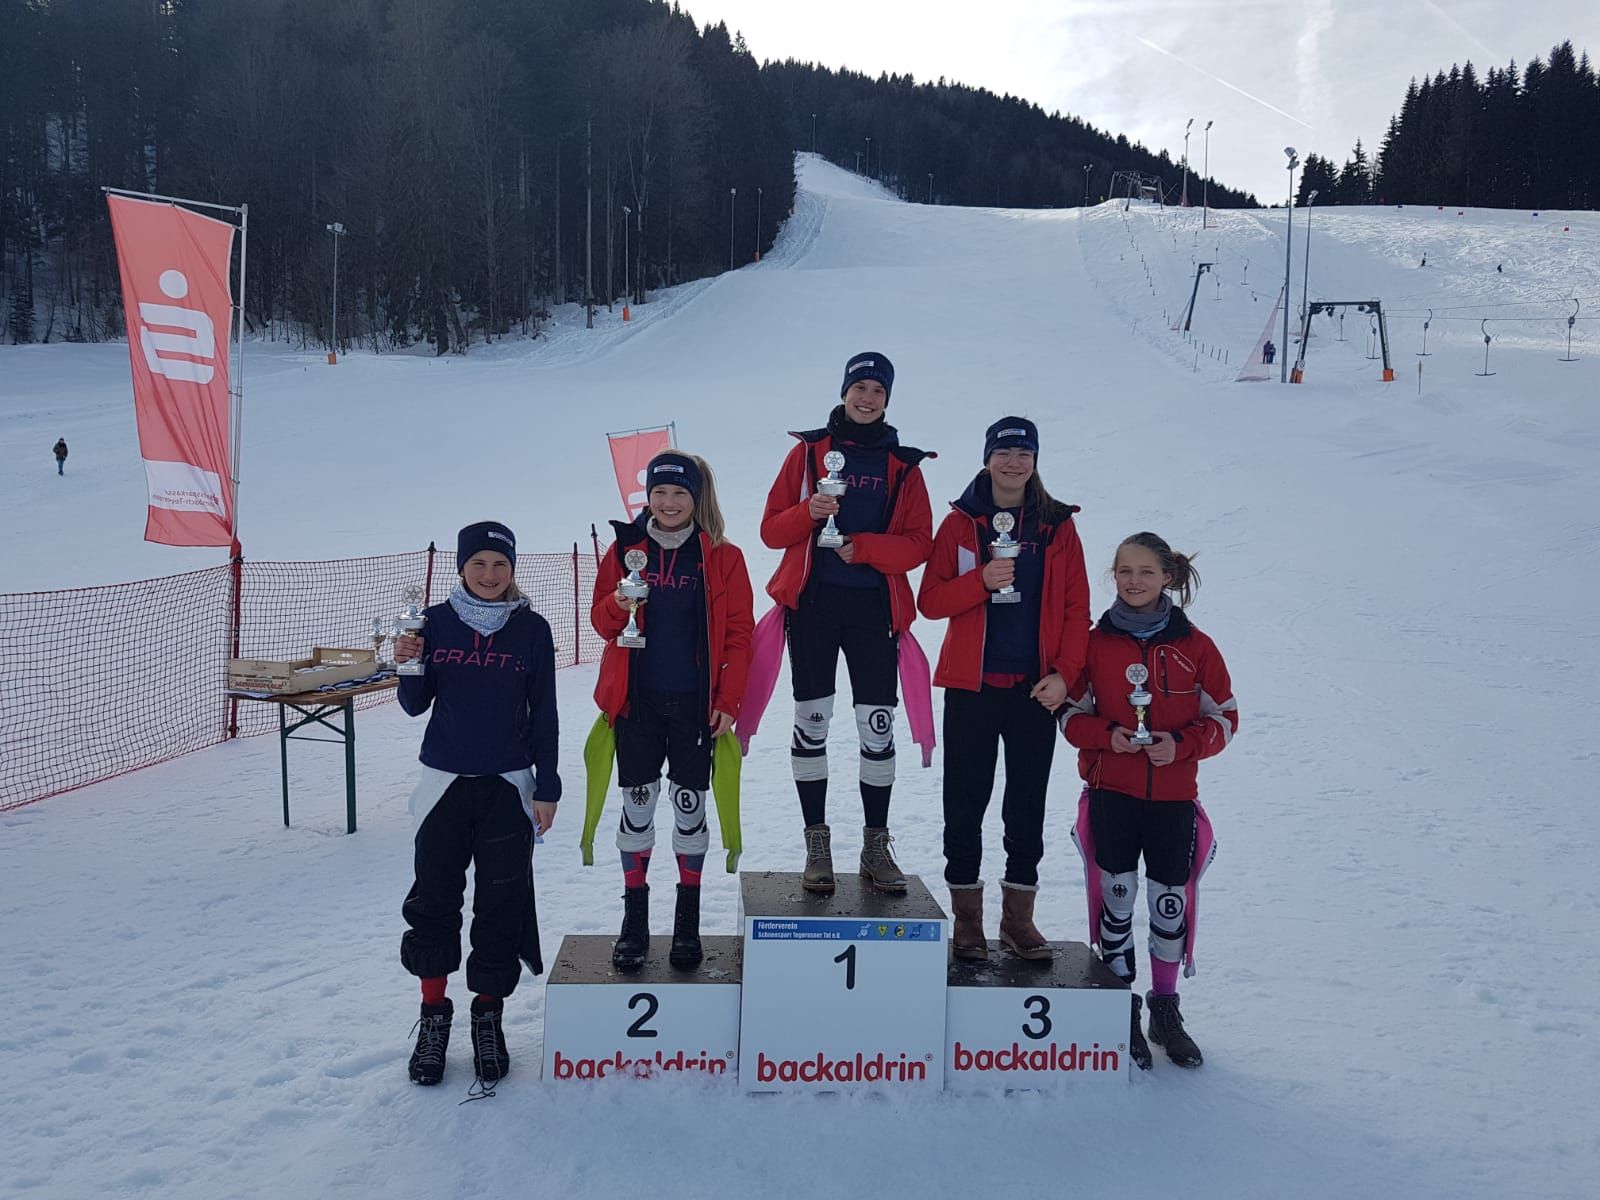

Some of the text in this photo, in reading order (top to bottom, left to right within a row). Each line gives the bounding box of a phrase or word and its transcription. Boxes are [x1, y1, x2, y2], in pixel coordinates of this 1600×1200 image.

[840, 474, 884, 491] AFT
[645, 572, 698, 592] RAFT
[433, 648, 513, 668] CRAFT
[876, 714, 887, 730] B
[681, 792, 693, 809] B
[1164, 898, 1177, 915] B
[758, 921, 798, 930] Förderverein
[834, 944, 856, 989] 1
[626, 992, 659, 1038] 2
[1022, 995, 1052, 1039] 3
[954, 1042, 1119, 1071] backaldrin
[757, 1053, 926, 1082] backaldrin
